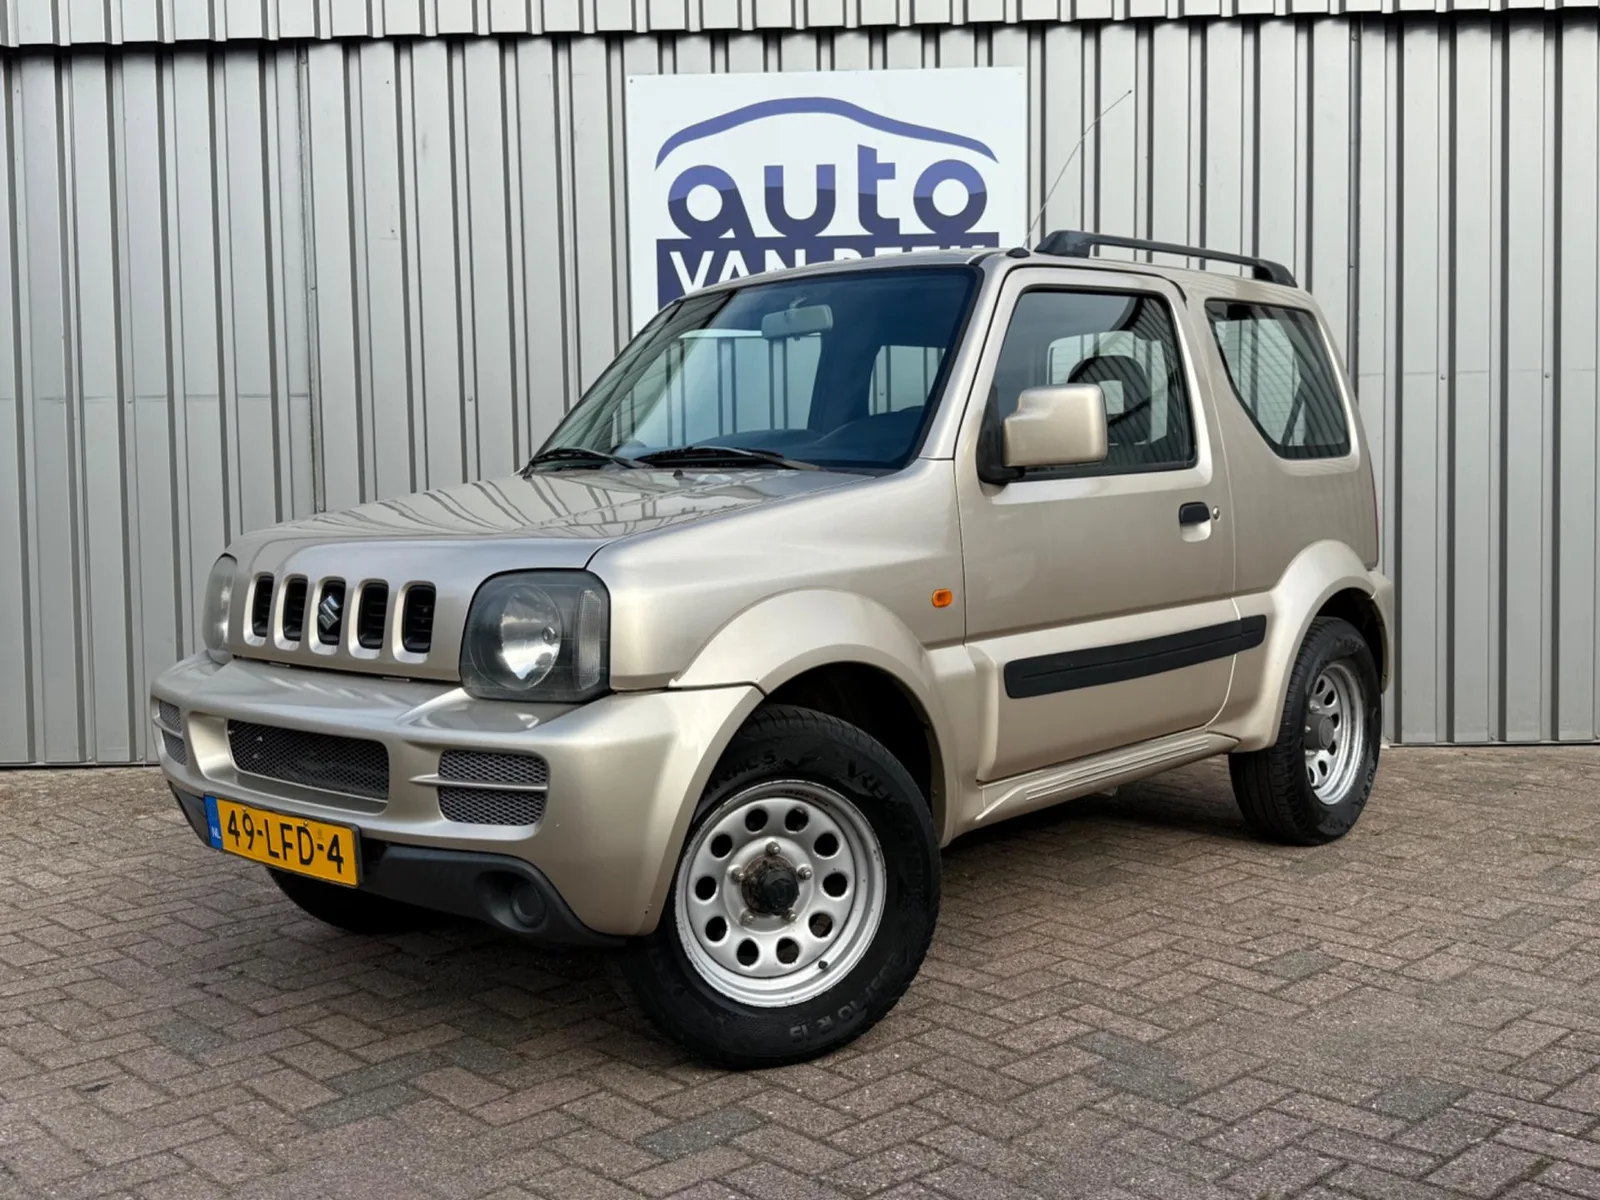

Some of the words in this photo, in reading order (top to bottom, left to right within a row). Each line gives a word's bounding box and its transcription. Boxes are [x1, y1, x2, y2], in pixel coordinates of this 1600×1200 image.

[668, 143, 988, 239] auto
[211, 826, 222, 839] NL
[227, 809, 345, 875] 49-LFD-4
